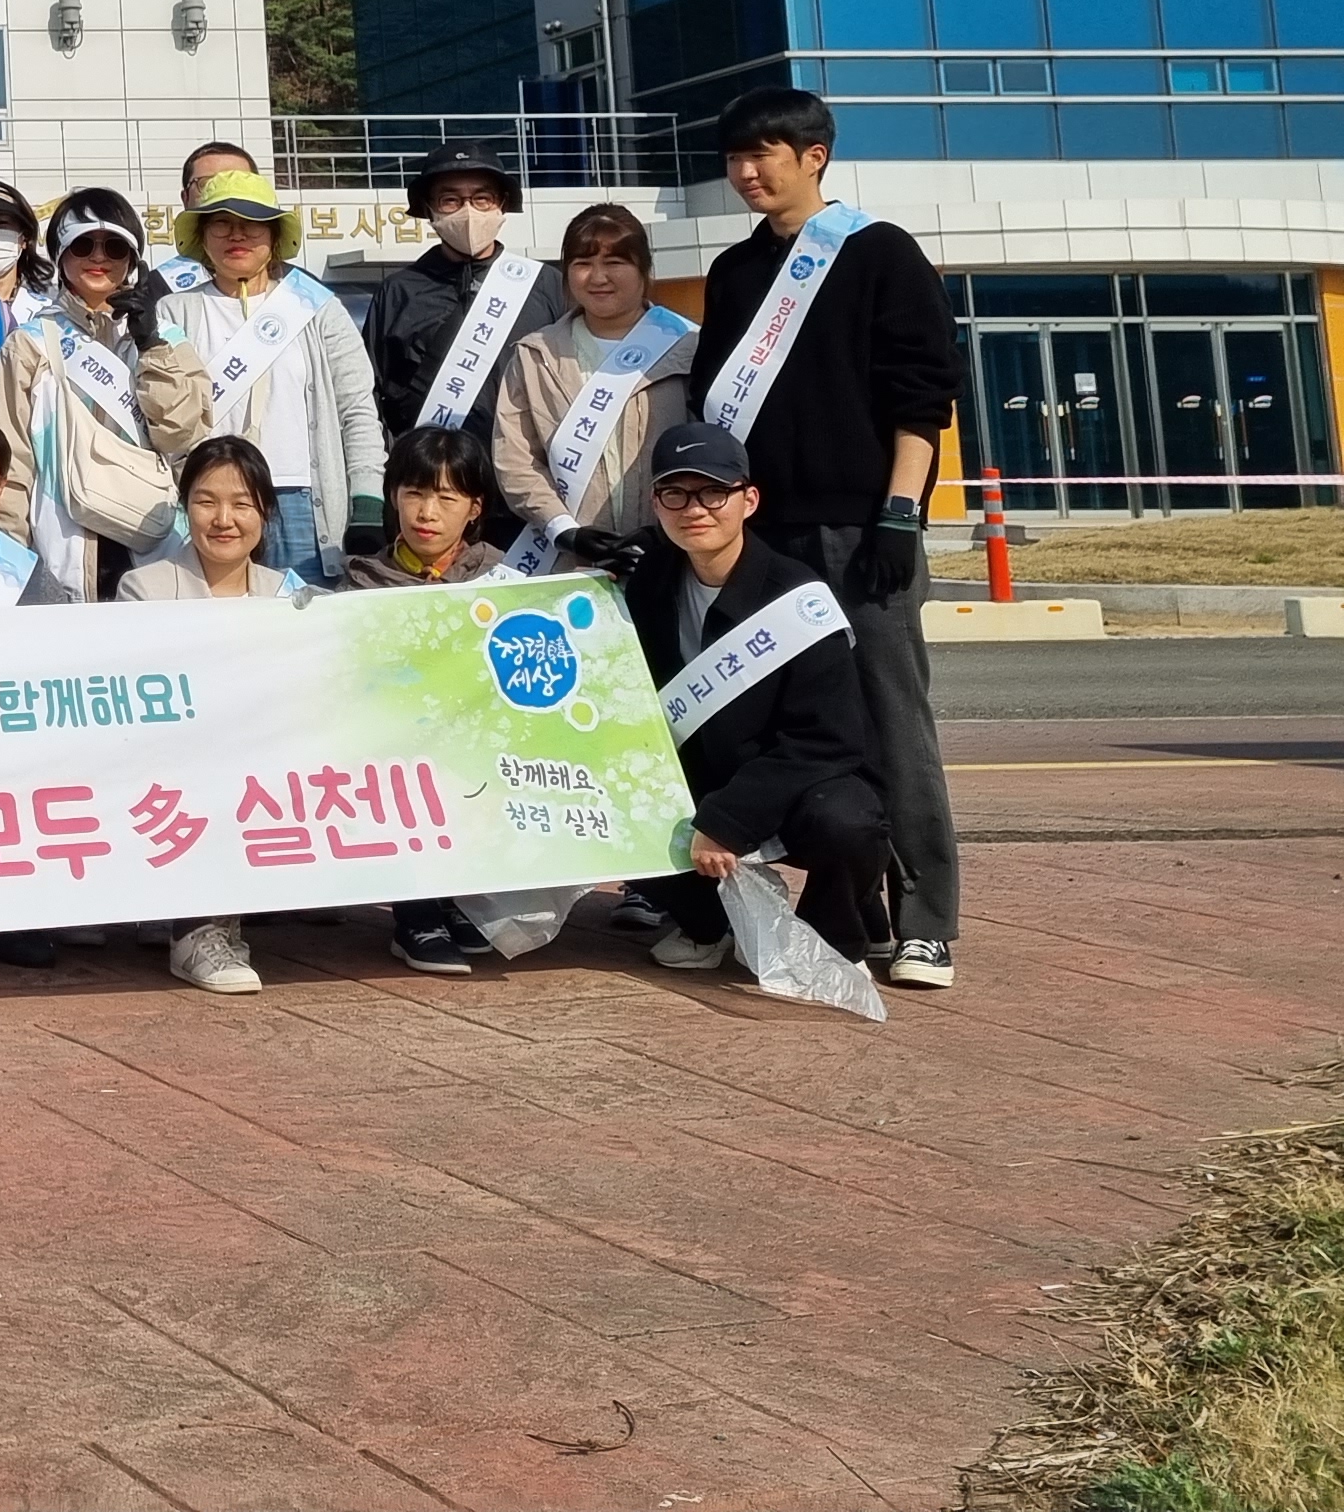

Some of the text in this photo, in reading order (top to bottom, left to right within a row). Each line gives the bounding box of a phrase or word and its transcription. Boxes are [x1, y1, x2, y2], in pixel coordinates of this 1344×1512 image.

[749, 296, 798, 366] 양심지킴
[732, 365, 758, 403] 내가
[507, 666, 563, 696] 세상
[500, 756, 604, 795] 함께해요.
[128, 782, 209, 870] 多
[236, 760, 452, 868] 실천!!
[505, 800, 609, 839] 청렴 실천
